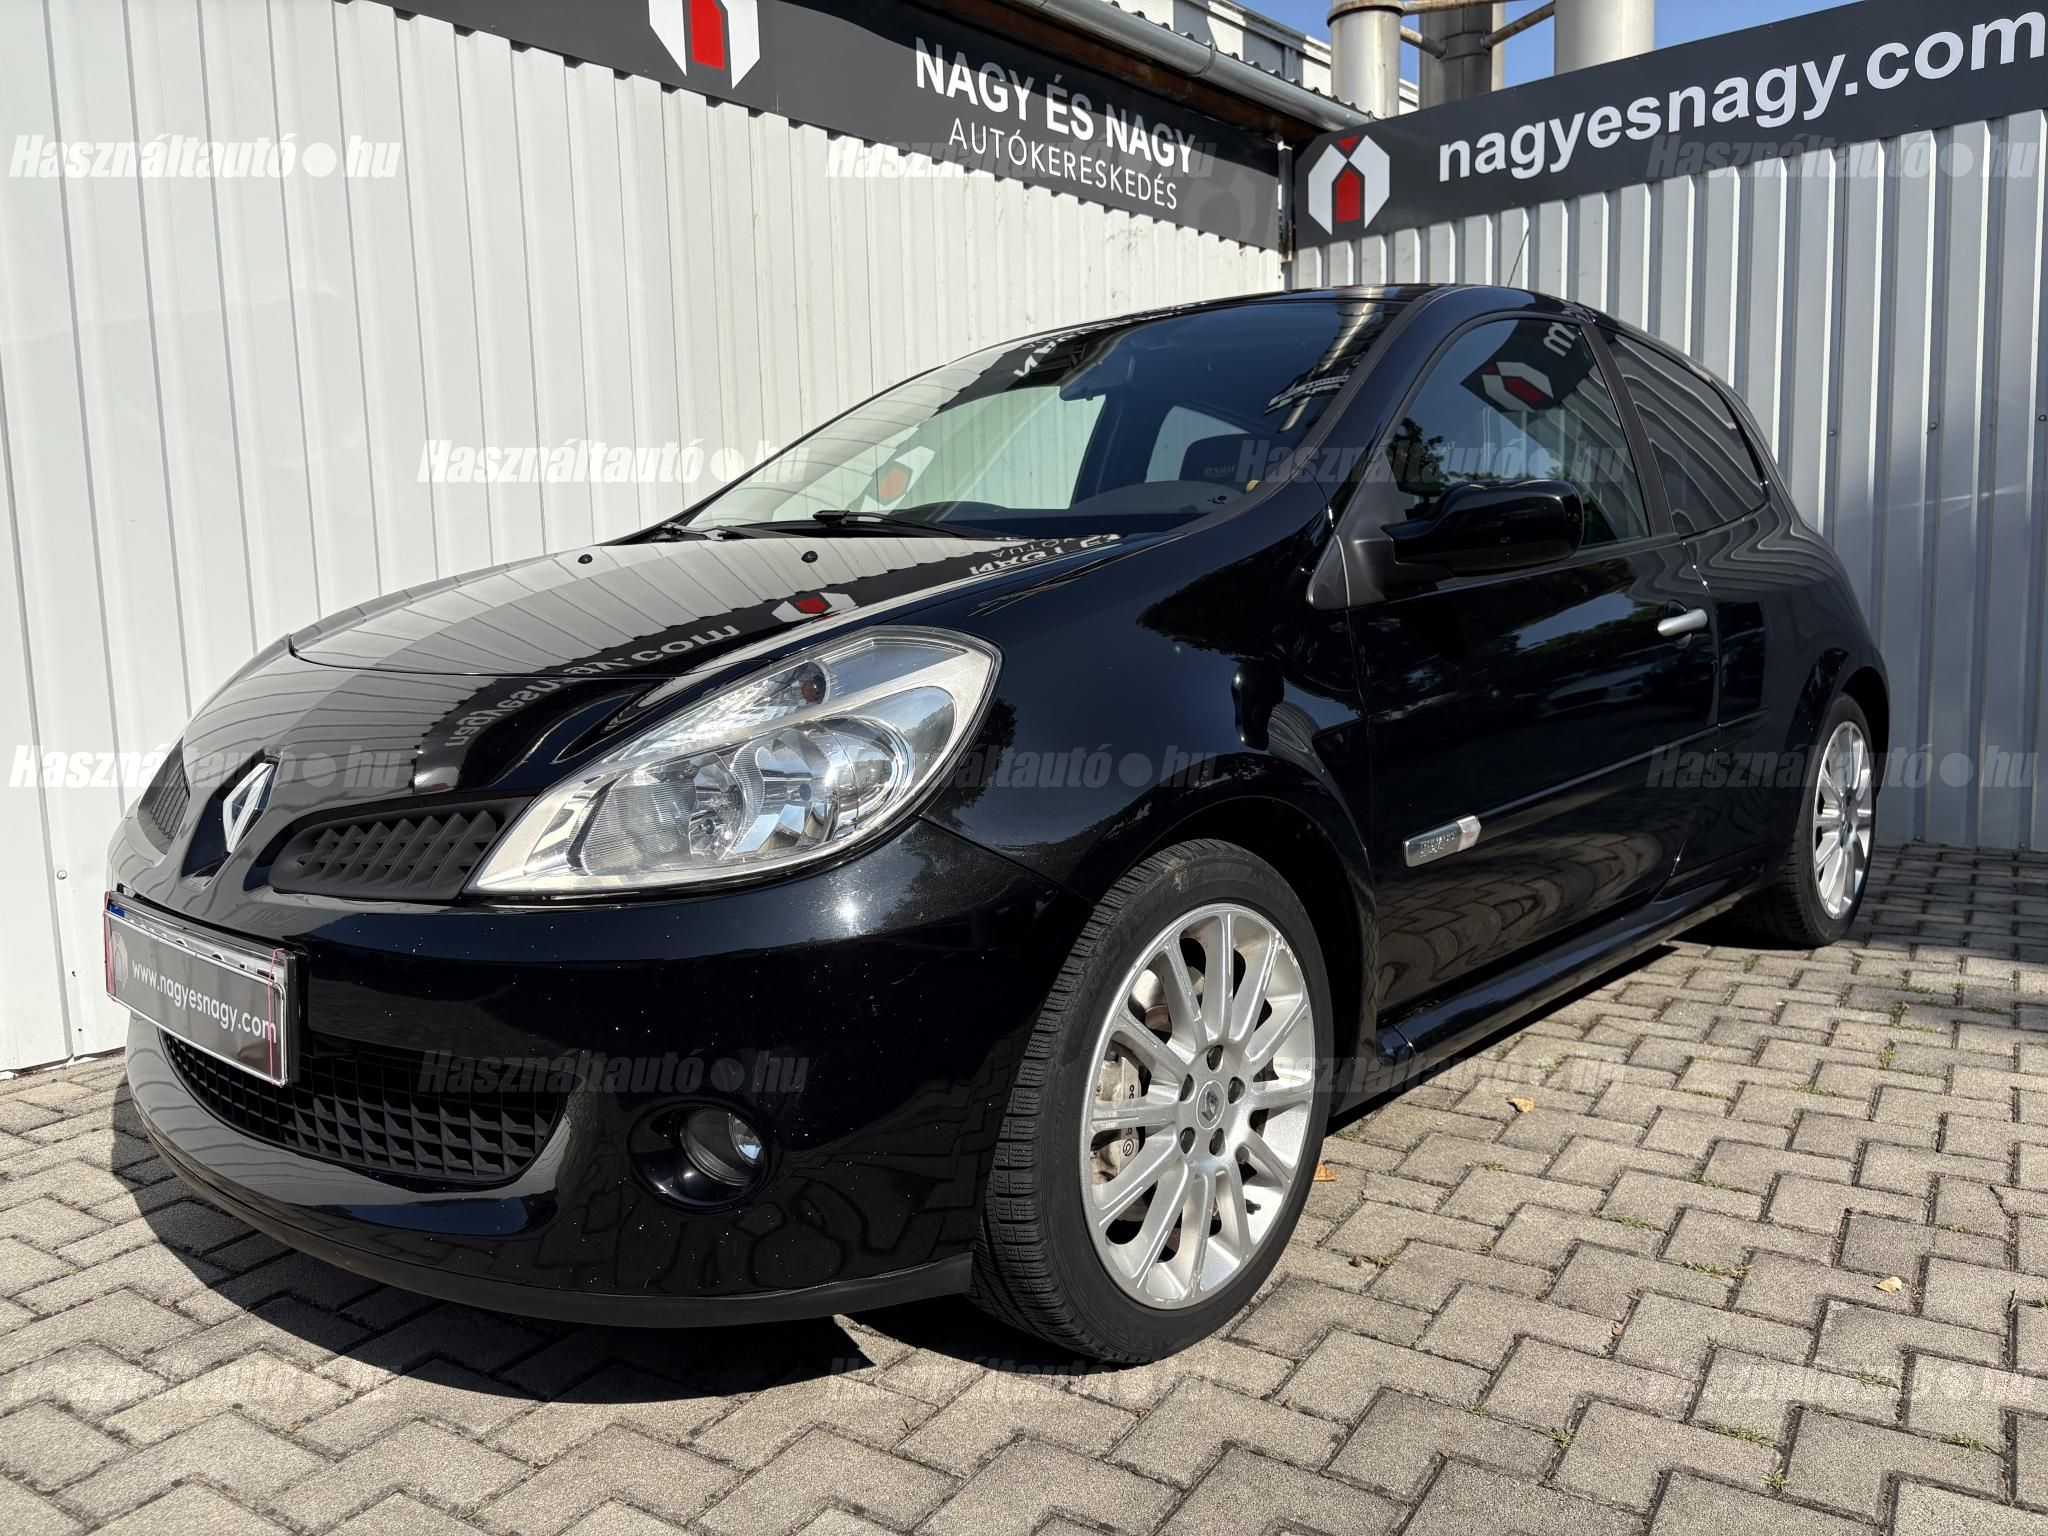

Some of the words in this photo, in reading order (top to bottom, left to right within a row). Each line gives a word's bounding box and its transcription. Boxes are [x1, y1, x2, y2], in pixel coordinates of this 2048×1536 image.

[915, 36, 1035, 121] NAGY
[1046, 73, 1094, 141] ÉS
[1105, 103, 1196, 173] NAGY
[1438, 10, 2047, 184] nagyesnagy.com
[948, 117, 1177, 210] AUTÓKERESKEDÉS
[131, 959, 278, 1044] www.nagyesnagy.com
